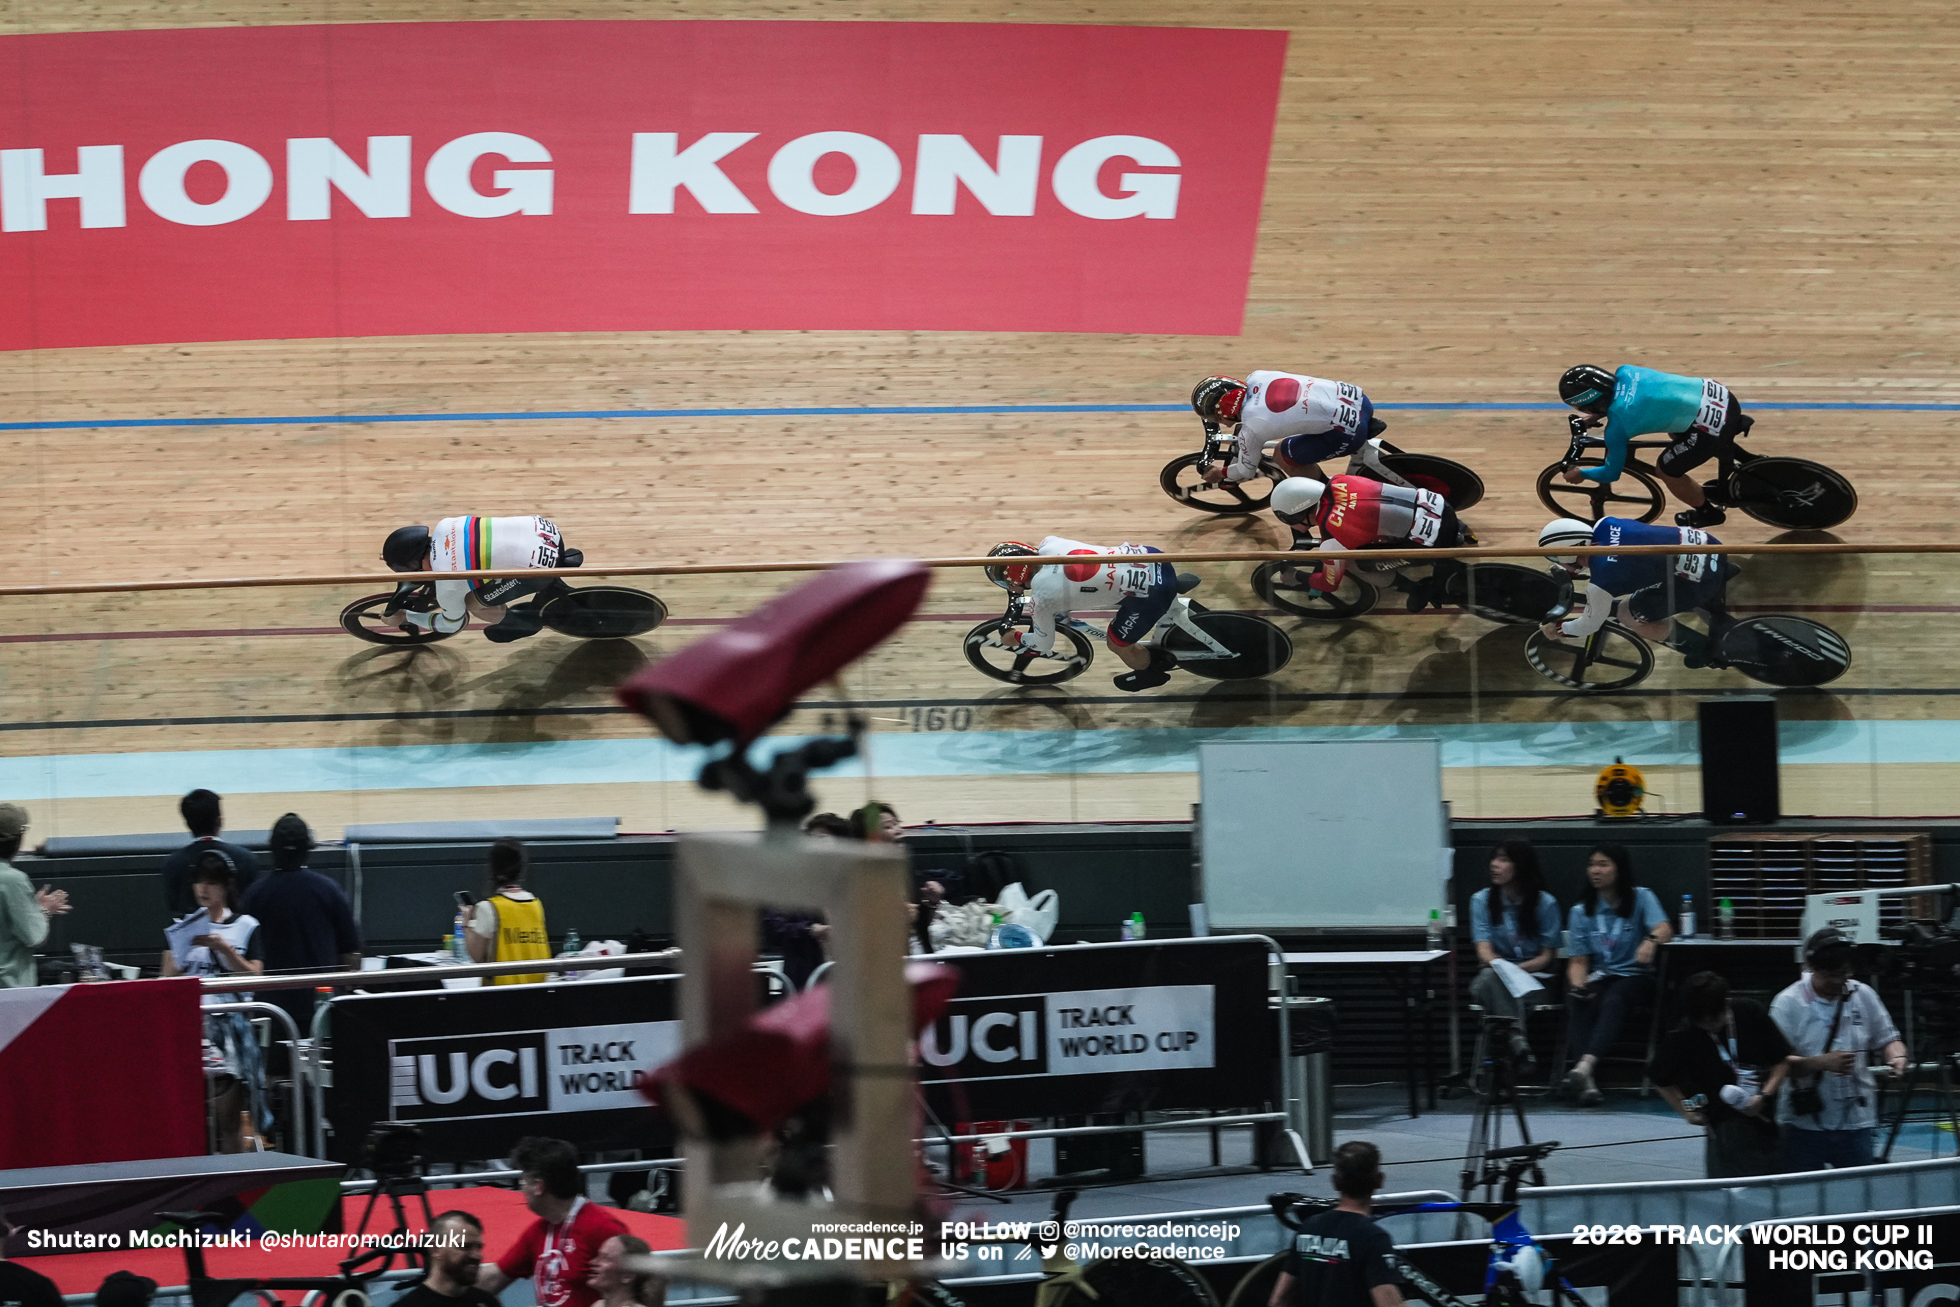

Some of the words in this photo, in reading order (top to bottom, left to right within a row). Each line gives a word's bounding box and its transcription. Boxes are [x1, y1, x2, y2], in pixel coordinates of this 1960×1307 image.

[0, 131, 555, 232] HONG
[628, 130, 1181, 220] KONG
[1230, 390, 1243, 414] JAPAN
[1339, 404, 1358, 429] 143
[1703, 404, 1723, 429] 119
[1328, 483, 1348, 528] CHINA
[1419, 516, 1434, 539] 74
[537, 545, 557, 569] 155
[1683, 554, 1700, 574] 93
[1127, 569, 1148, 592] 142
[910, 706, 972, 733] 160
[1057, 1004, 1136, 1029] TRACK
[920, 1010, 1038, 1067] UCI
[1058, 1033, 1149, 1058] WORLD
[1154, 1030, 1200, 1053] CUP
[557, 1040, 636, 1066] TRACK
[417, 1047, 539, 1105] UCI
